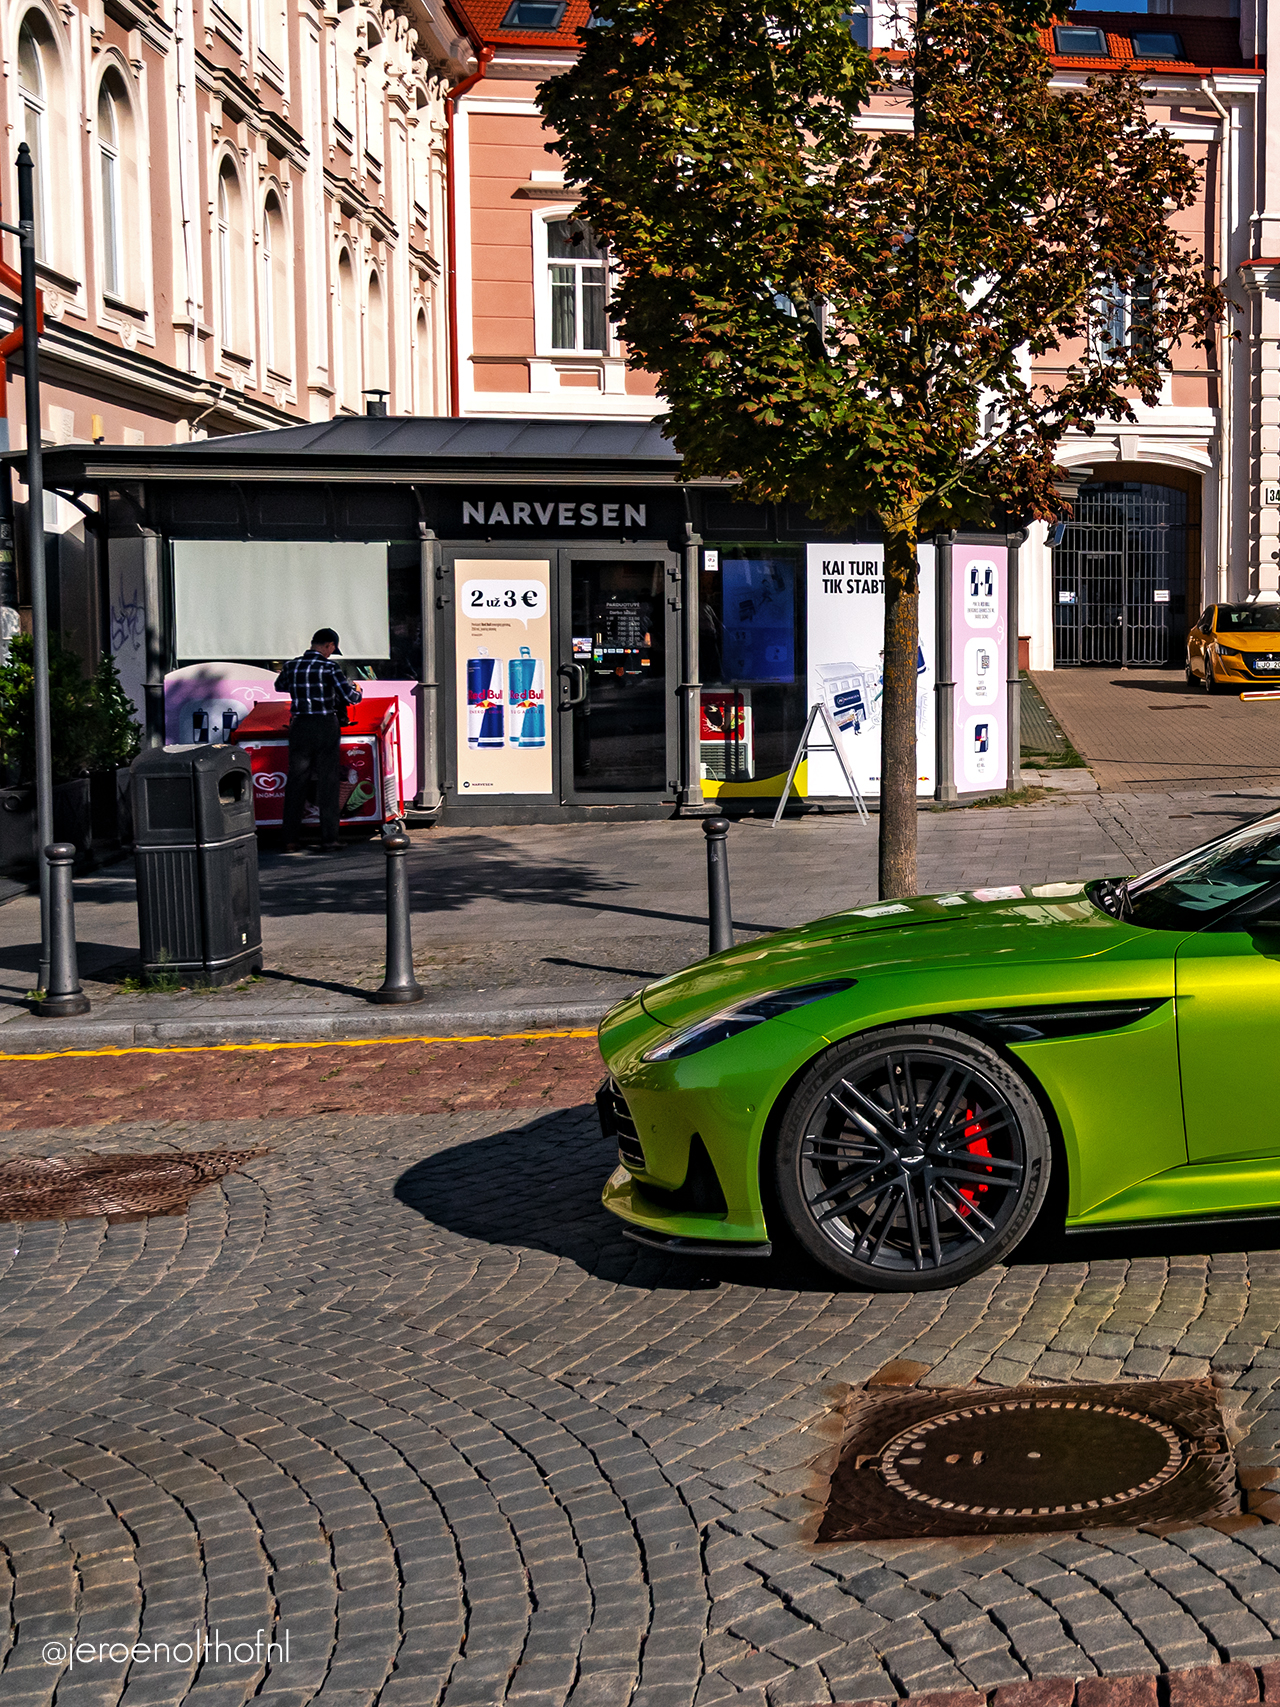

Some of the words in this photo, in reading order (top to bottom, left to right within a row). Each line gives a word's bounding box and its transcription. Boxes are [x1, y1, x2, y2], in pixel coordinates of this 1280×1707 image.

[1269, 489, 1280, 501] 34
[462, 501, 647, 527] NARVESEN
[822, 561, 844, 576] KAI
[848, 561, 878, 576] TURI
[822, 579, 842, 594] TIK
[471, 590, 484, 608] 2
[486, 597, 501, 608] už
[504, 590, 517, 608] 3
[521, 590, 538, 608] €
[468, 689, 486, 699] Red
[510, 689, 527, 699] Red
[784, 1076, 824, 1143] MICHELIN
[1000, 1180, 1039, 1248] MICHELIN
